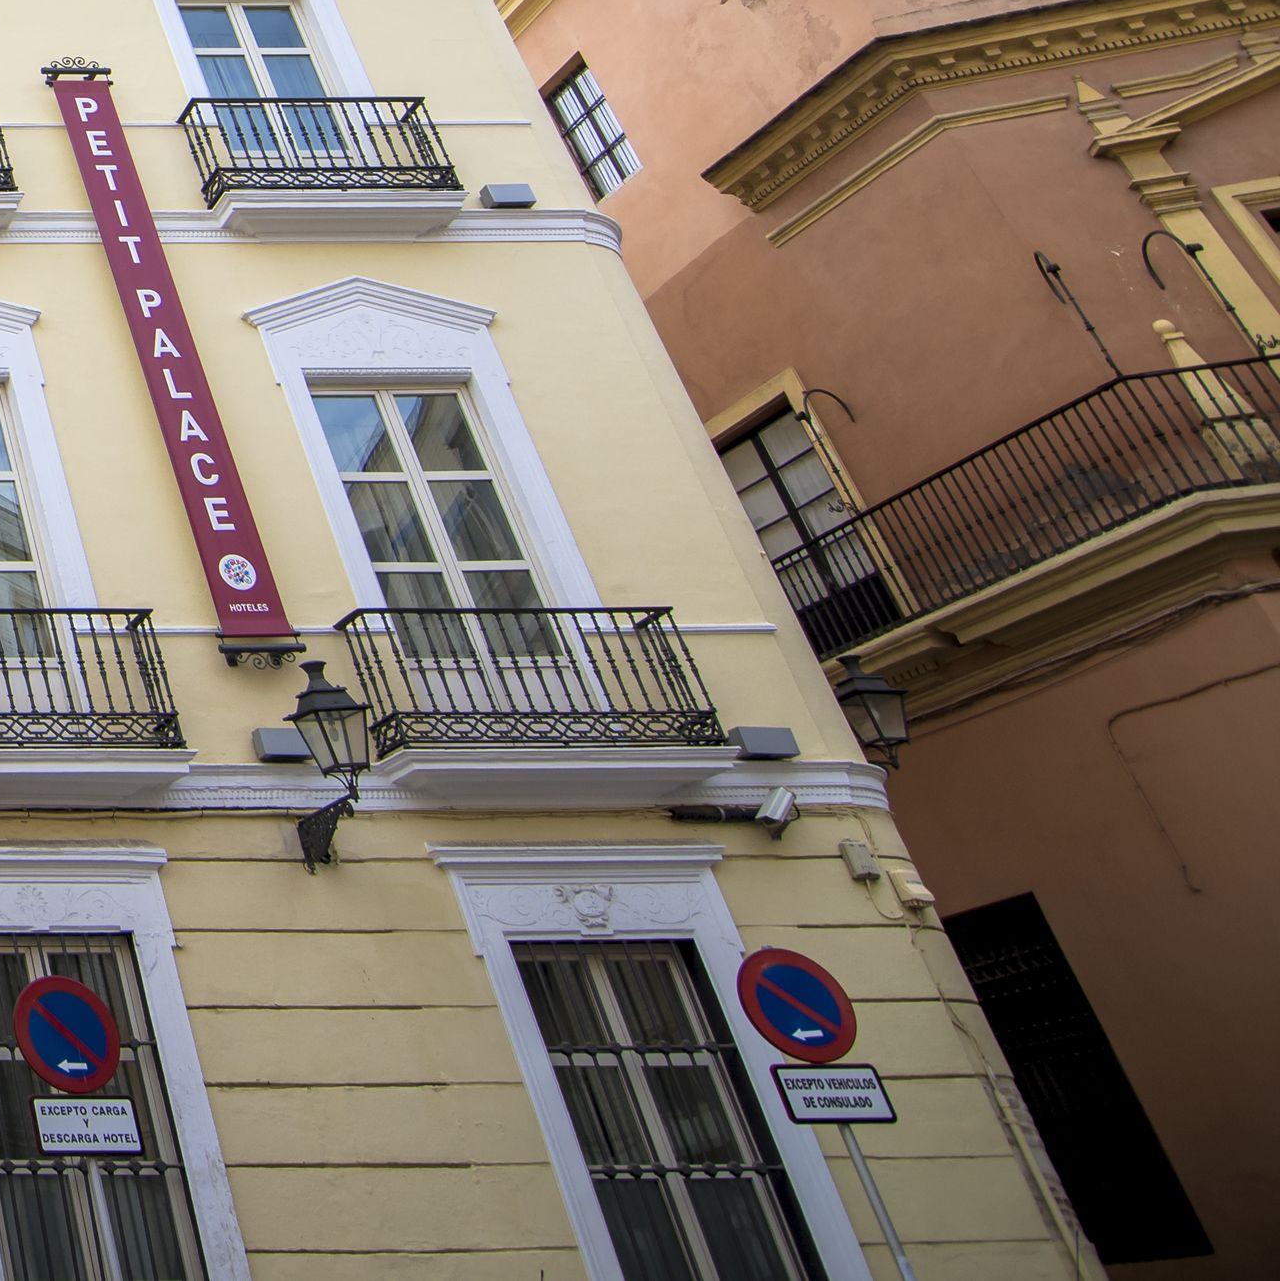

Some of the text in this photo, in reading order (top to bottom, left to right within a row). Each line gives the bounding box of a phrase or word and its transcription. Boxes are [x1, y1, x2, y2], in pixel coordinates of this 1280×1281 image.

[74, 97, 237, 531] PETIT PALACE
[229, 603, 269, 612] HOTELES
[784, 1078, 877, 1090] EXCEPTO VEHICULOS
[803, 1096, 873, 1108] DE CONSULADO
[41, 1105, 128, 1116] EXCEPTO CARGA
[83, 1119, 89, 1128] Y
[42, 1133, 138, 1144] DESCARGA HOTEL
